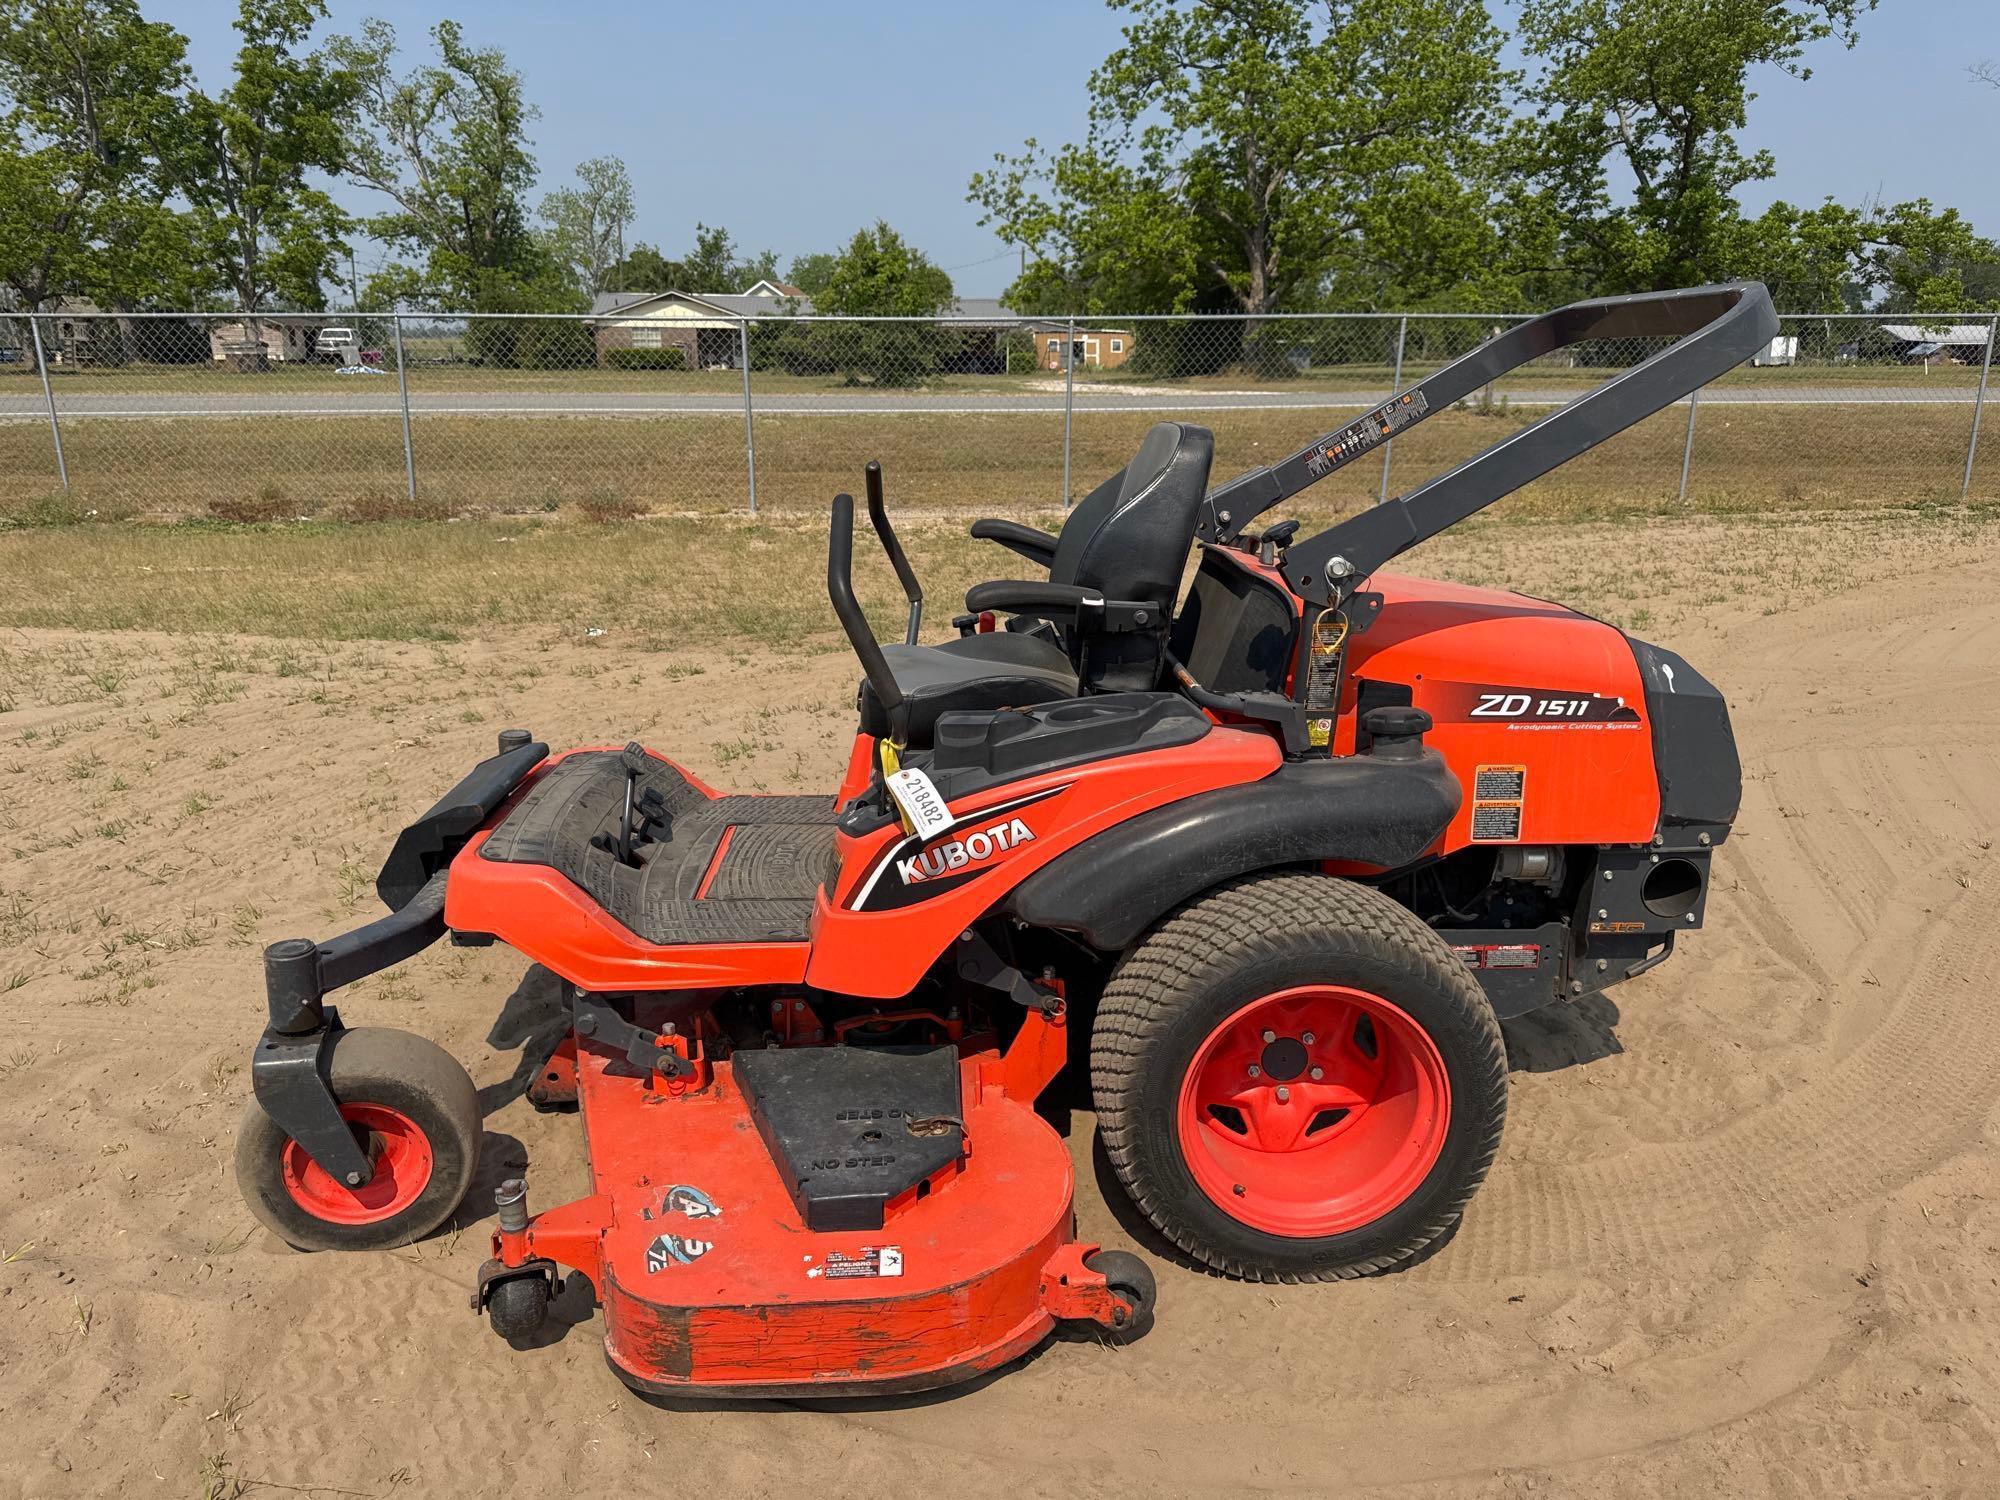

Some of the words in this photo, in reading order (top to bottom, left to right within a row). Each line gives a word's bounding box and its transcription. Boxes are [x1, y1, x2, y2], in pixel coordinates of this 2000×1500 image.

[1470, 694, 1532, 716] ZD
[1536, 700, 1591, 716] 1511
[1506, 723, 1565, 731] Aerodynamic
[1568, 723, 1603, 731] Cutting
[906, 778, 943, 826] 218482
[896, 817, 1037, 886] KUBOTA
[836, 1109, 883, 1121] STEP
[888, 1109, 915, 1120] NO
[811, 1158, 840, 1171] NO
[845, 1155, 896, 1168] STEP
